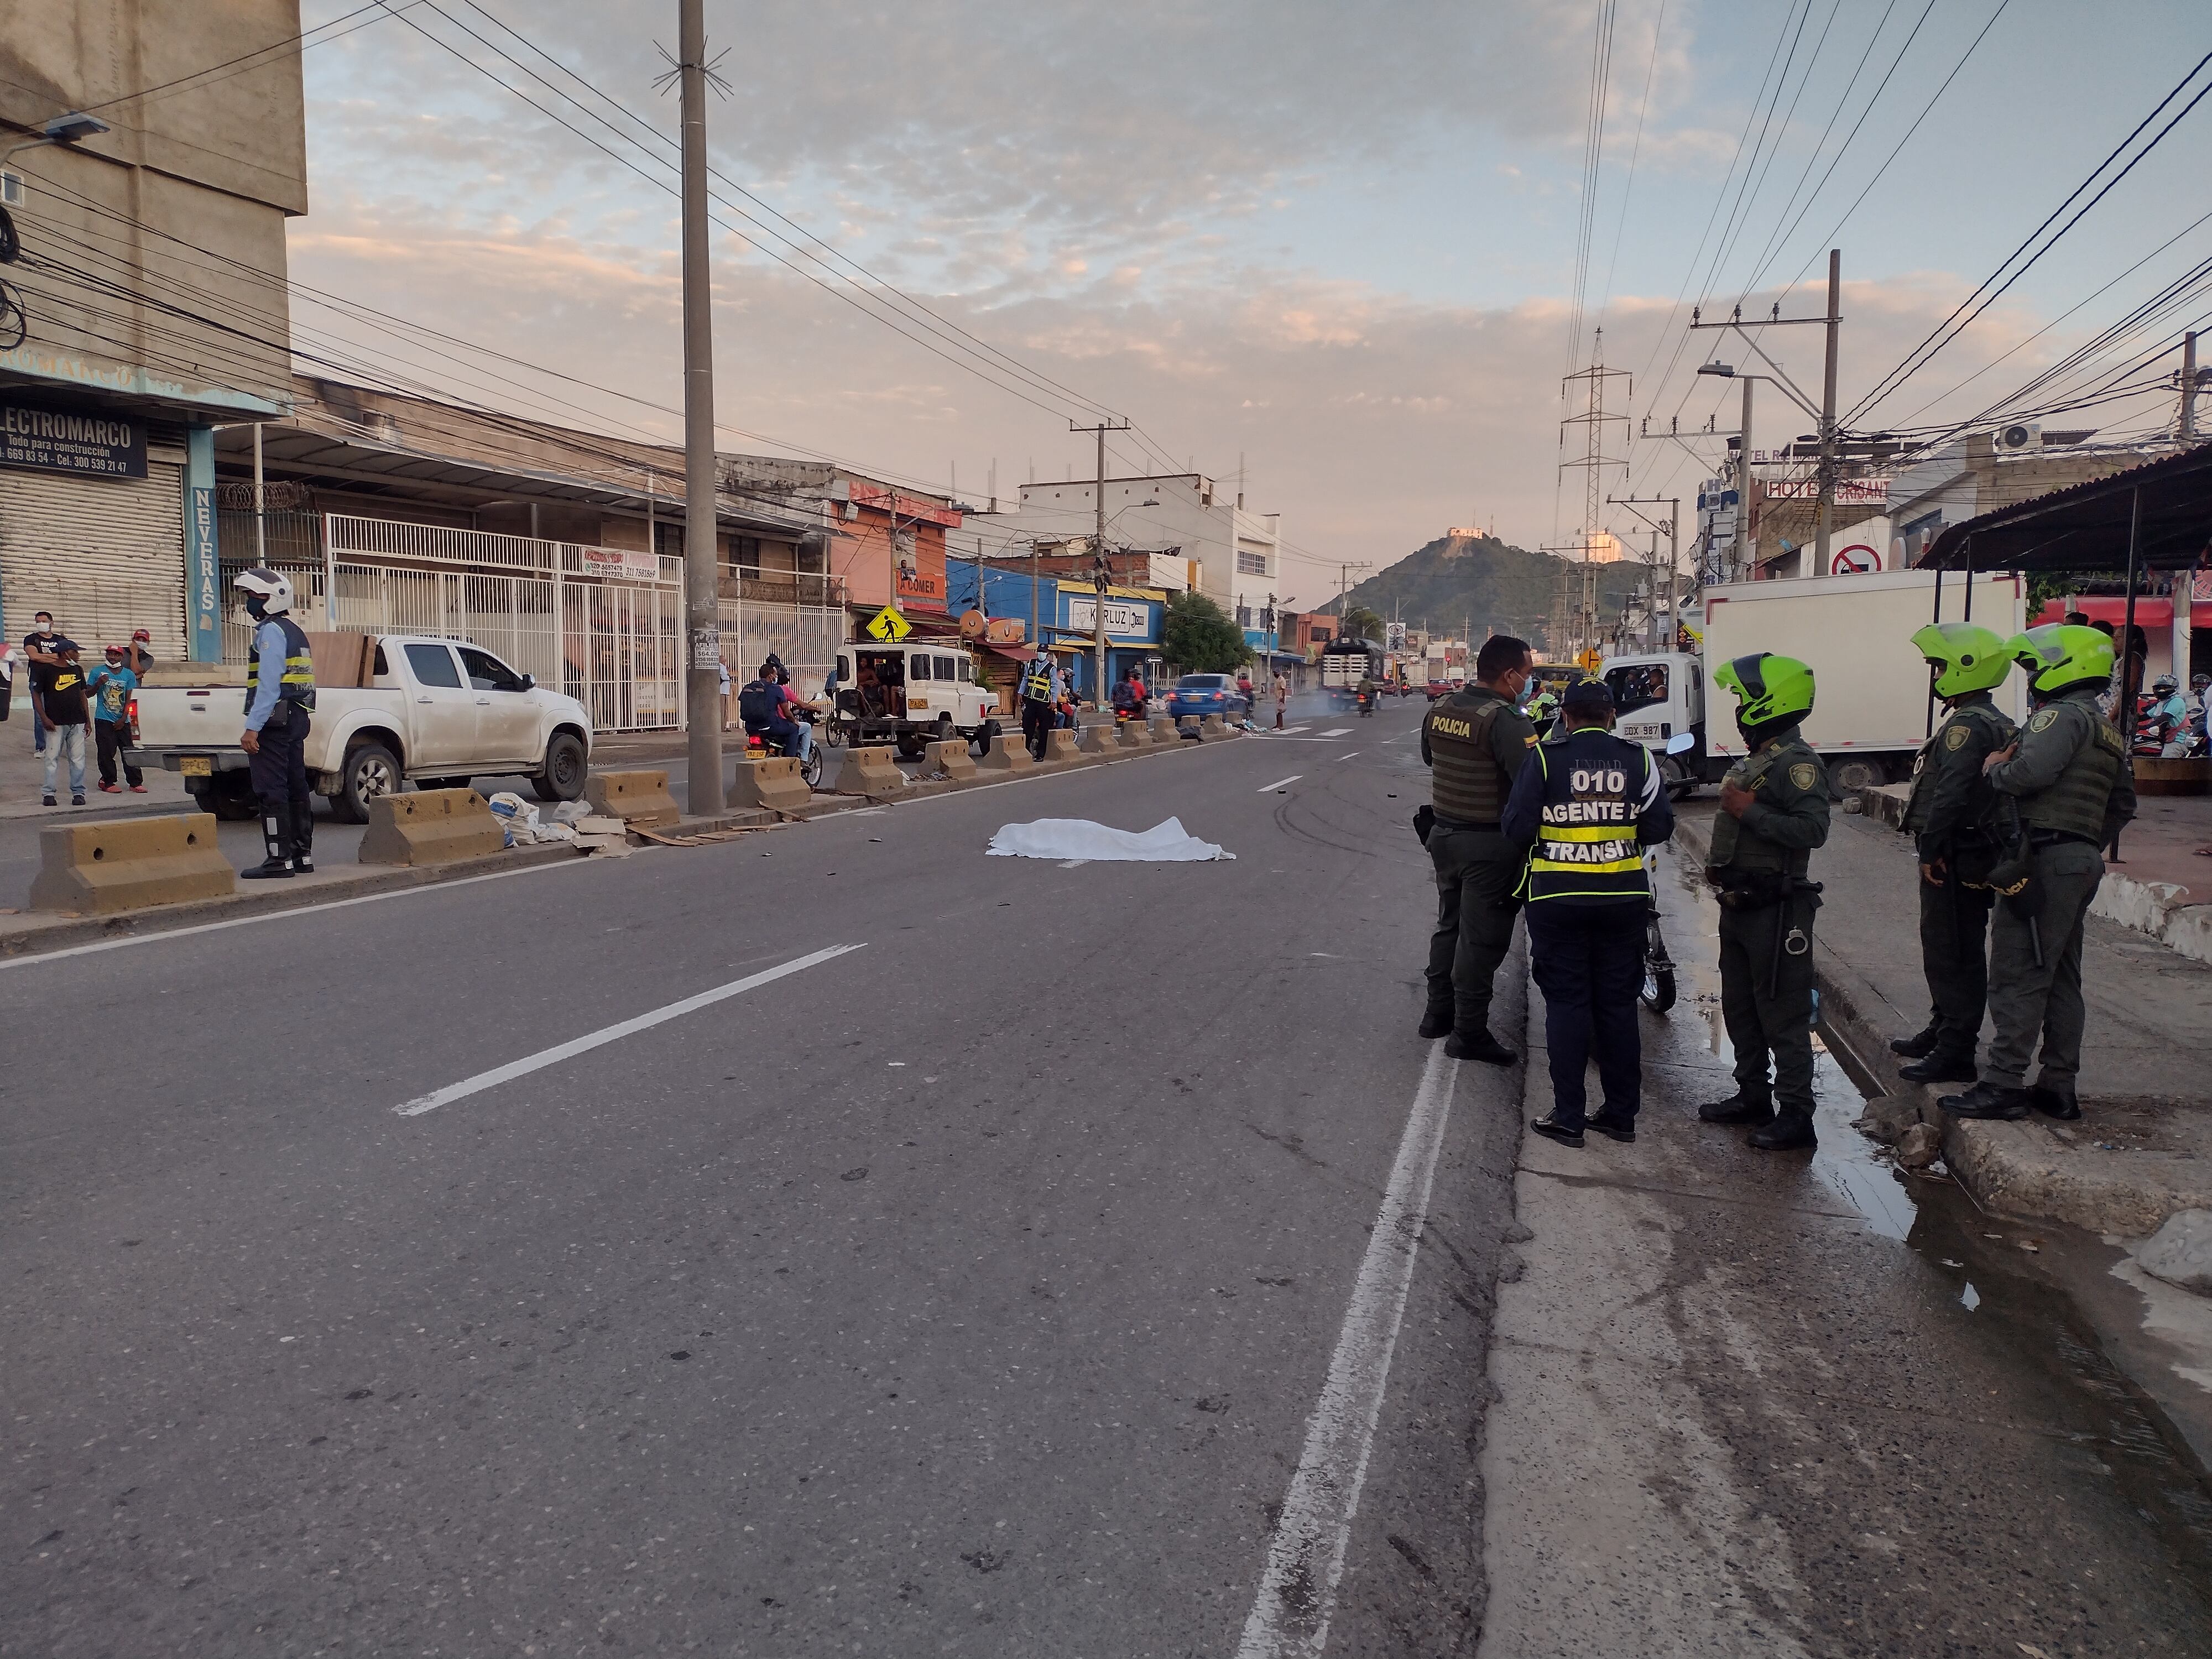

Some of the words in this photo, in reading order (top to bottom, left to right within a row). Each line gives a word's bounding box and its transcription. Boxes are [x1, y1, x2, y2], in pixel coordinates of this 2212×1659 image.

[8, 434, 28, 447] Todo
[32, 440, 51, 450] para
[54, 442, 110, 457] construcción
[7, 447, 23, 460] 669
[25, 450, 35, 461] 83
[38, 451, 49, 463] 54
[57, 454, 72, 466] Cel:
[74, 456, 89, 468] 300
[91, 458, 106, 470] 539
[108, 461, 116, 471] 21
[118, 461, 127, 472] 47
[1730, 450, 1768, 461] HTEL
[1770, 482, 1819, 497] HOTE
[1837, 481, 1890, 499] CRISANT
[195, 490, 214, 610] NEVERAS
[635, 568, 656, 578] 7581869
[907, 578, 935, 594] COMER
[1090, 608, 1126, 624] KRLUZ
[59, 674, 76, 684] NIKE
[1432, 716, 1470, 738] POLICIA
[1644, 726, 1658, 735] 987
[1573, 770, 1625, 792] 010
[1542, 802, 1625, 823] AGENTE
